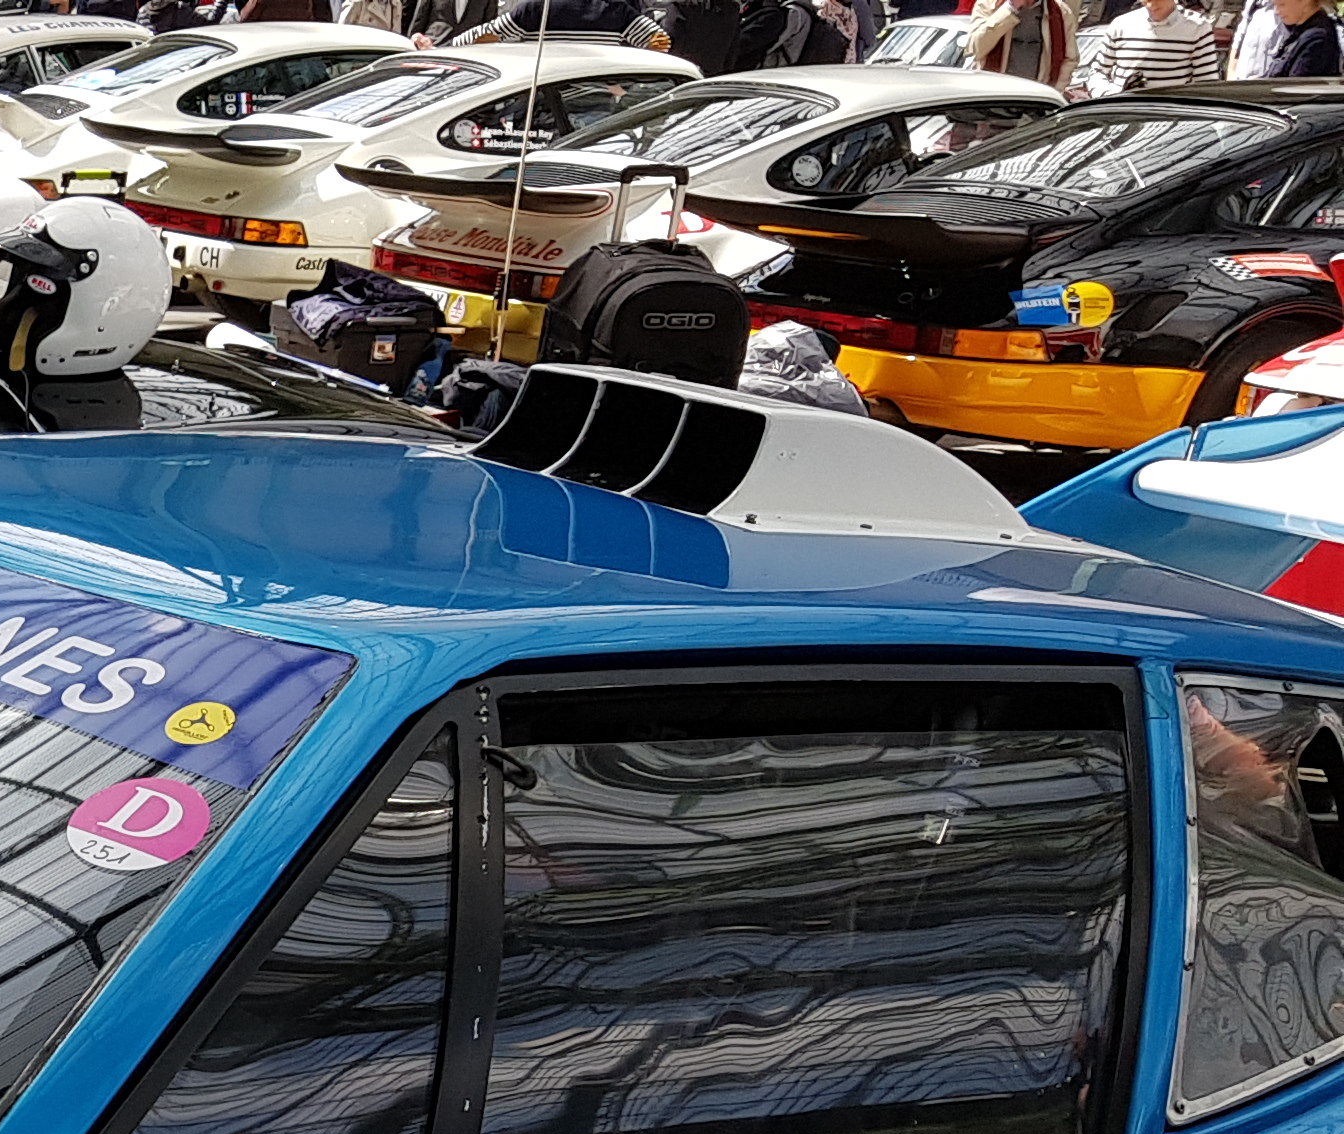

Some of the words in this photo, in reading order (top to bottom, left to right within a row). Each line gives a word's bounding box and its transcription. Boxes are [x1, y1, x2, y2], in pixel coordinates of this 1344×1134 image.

[199, 246, 221, 268] CH
[31, 277, 53, 292] BELL
[642, 312, 716, 330] OGIO
[96, 786, 184, 839] D
[79, 839, 132, 865] 251
